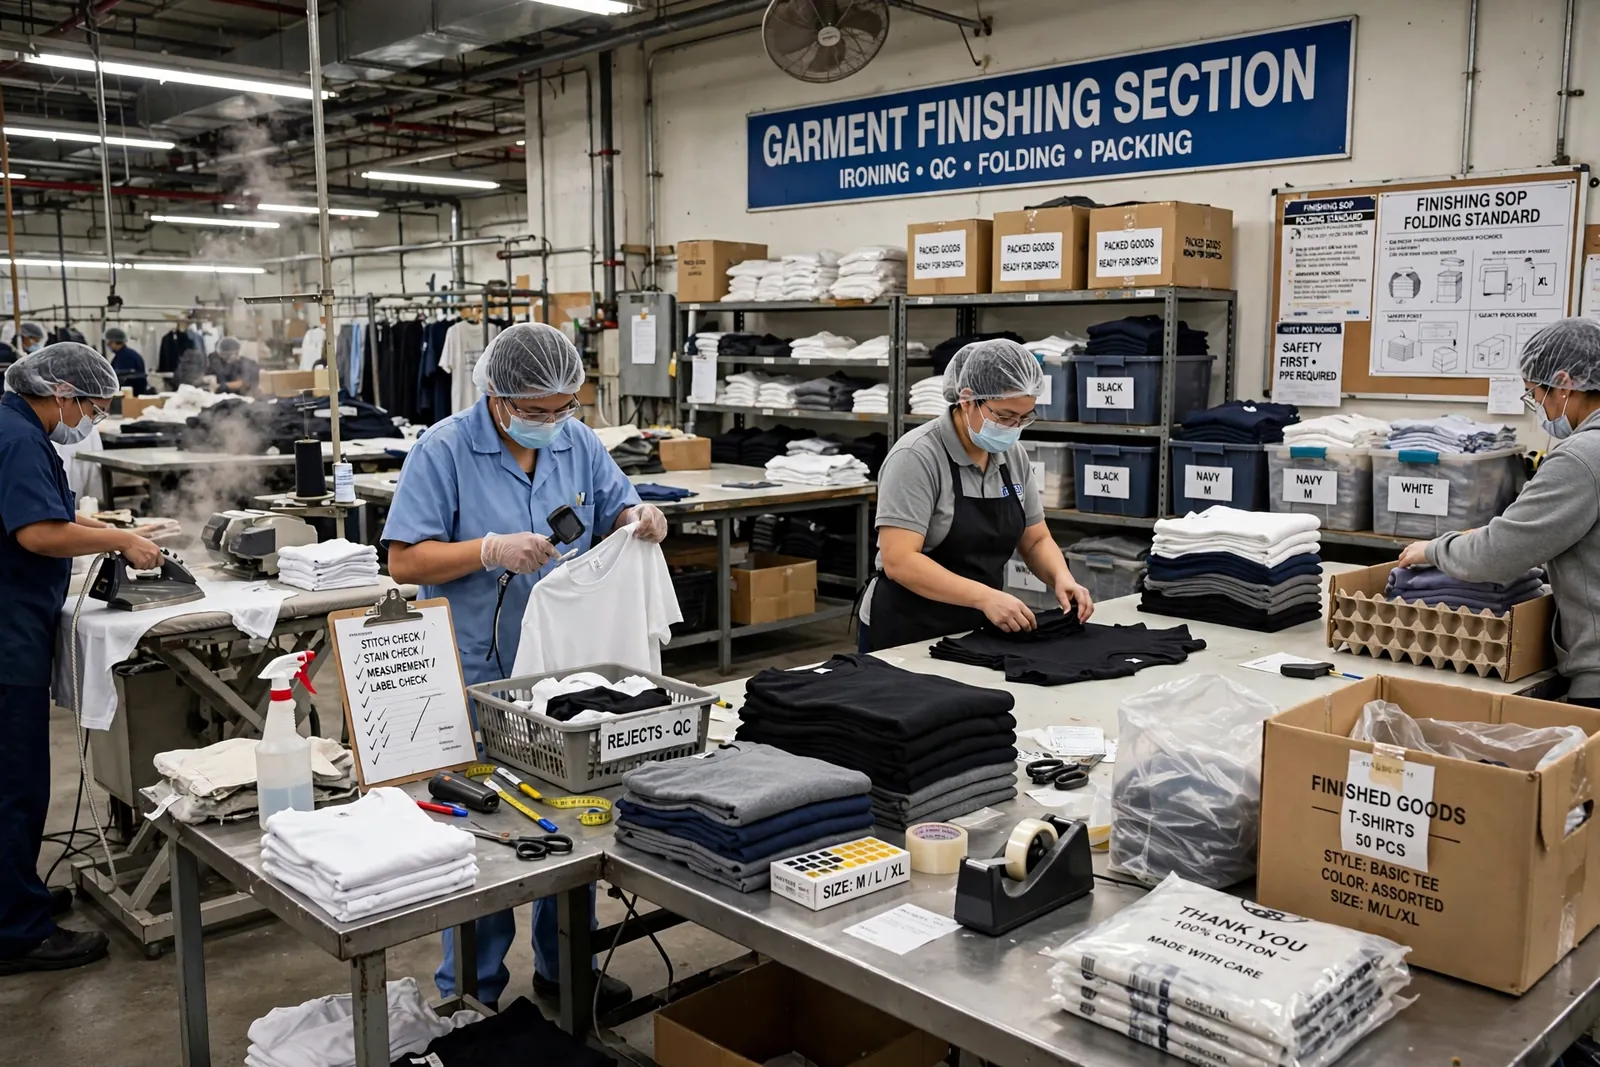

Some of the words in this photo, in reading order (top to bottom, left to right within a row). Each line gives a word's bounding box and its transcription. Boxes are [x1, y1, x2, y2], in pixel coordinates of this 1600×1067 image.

[763, 106, 909, 168] GARMENT
[918, 77, 1100, 148] FINISHING
[1113, 44, 1317, 124] SECTION
[839, 162, 910, 189] IRONING
[929, 156, 957, 180] QC
[978, 143, 1065, 175] FOLDING
[1091, 129, 1193, 163] PACKING
[1417, 193, 1490, 212] FINISHING
[1495, 190, 1528, 207] SOP
[1404, 213, 1462, 231] FOLDING
[1465, 208, 1541, 227] STANDARD
[919, 244, 941, 255] PACKED
[941, 243, 961, 253] GOODS
[1007, 243, 1031, 254] PACKED
[1032, 242, 1055, 253] GOODS
[1104, 240, 1129, 251] PACKED
[1130, 238, 1155, 249] GOODS
[1003, 262, 1020, 272] READY
[1021, 261, 1033, 271] FOR
[1033, 260, 1059, 271] DISPATCH
[1099, 258, 1117, 268] READY
[1118, 257, 1130, 267] FOR
[1131, 256, 1159, 267] DISPATCH
[1282, 341, 1322, 353] SAFETY
[1280, 356, 1309, 368] FIRST
[1279, 370, 1294, 380] PPE
[1296, 370, 1337, 382] REQUIRED
[1097, 382, 1123, 392] BLACK
[1104, 395, 1115, 406] XL
[1093, 471, 1120, 482] BLACK
[1196, 471, 1221, 483] NAVY
[1296, 474, 1323, 486] NAVY
[1100, 484, 1111, 494] XL
[1203, 485, 1212, 495] M
[1304, 488, 1312, 499] M
[1401, 482, 1434, 495] WHITE
[1414, 498, 1420, 509] L
[361, 635, 390, 650] STITCH
[392, 631, 421, 645] CHECK
[363, 649, 389, 664] STAIN
[391, 645, 420, 660] CHECK
[367, 658, 430, 678] MEASUREMENT
[370, 678, 398, 693] LABEL
[399, 674, 428, 688] CHECK
[608, 725, 663, 750] REJECTS
[673, 719, 691, 736] QC
[1311, 774, 1391, 807] FINISHED
[1397, 795, 1467, 825] GOODS
[1348, 809, 1415, 838] T-SHIRTS
[1355, 833, 1372, 848] 50
[1376, 838, 1406, 857] PCS
[1324, 849, 1367, 872] STYLE:
[1370, 861, 1410, 884] BASIC
[1414, 872, 1440, 892] TEE
[823, 879, 853, 900] SIZE:
[856, 875, 866, 890] M
[875, 870, 882, 884] L
[891, 863, 905, 878] XL
[1321, 867, 1369, 893] COLOR:
[1371, 882, 1444, 913] ASSORTED
[1330, 889, 1364, 911] SIZE:
[1367, 899, 1420, 927] M/L/XL
[1178, 905, 1256, 936] THANK
[1257, 929, 1309, 953] YOU
[1174, 920, 1211, 937] 100%
[1215, 933, 1277, 959] COTTON
[1147, 935, 1187, 953] MADE
[1188, 947, 1223, 966] WITH
[1224, 961, 1264, 980] CARE
